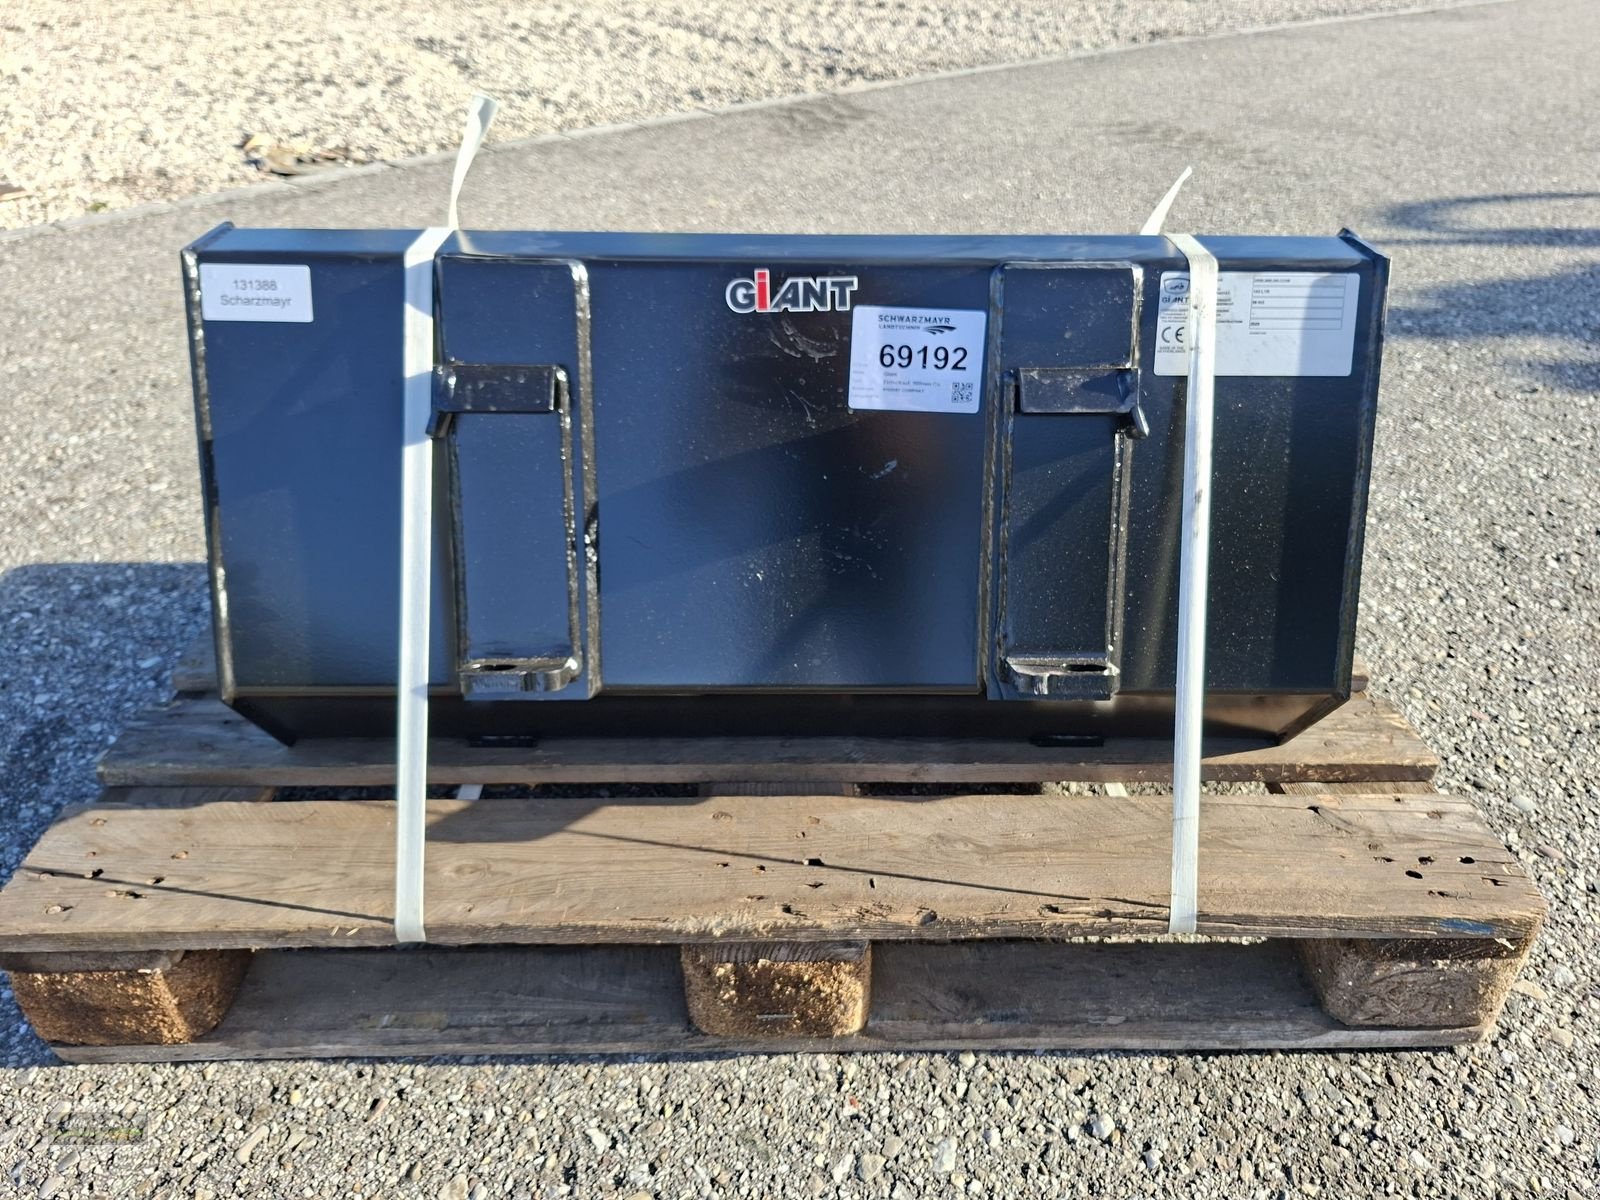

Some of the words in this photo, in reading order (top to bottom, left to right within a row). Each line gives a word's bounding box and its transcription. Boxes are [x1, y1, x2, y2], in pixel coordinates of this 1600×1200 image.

[220, 294, 292, 308] Scharzmayr
[878, 314, 951, 325] SCHWARZMAYR
[880, 344, 968, 371] 69192
